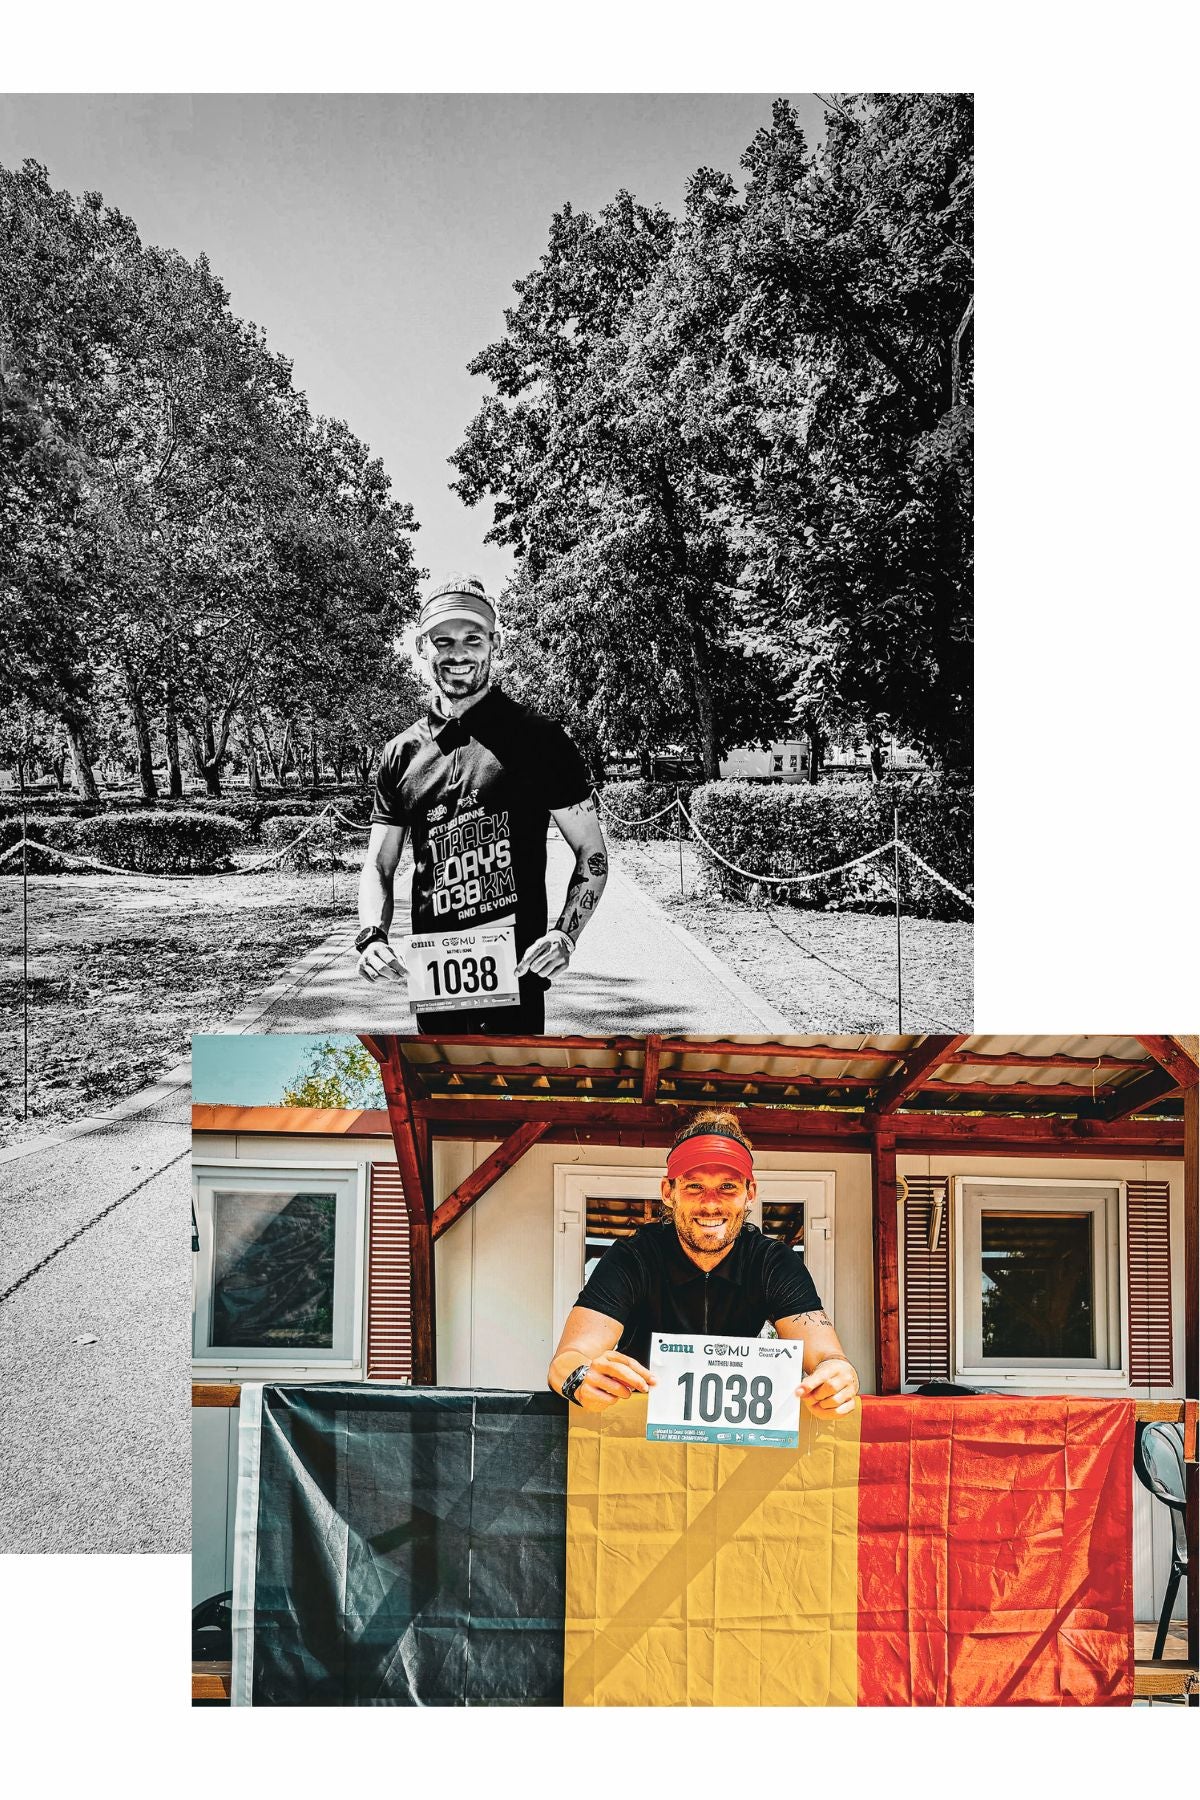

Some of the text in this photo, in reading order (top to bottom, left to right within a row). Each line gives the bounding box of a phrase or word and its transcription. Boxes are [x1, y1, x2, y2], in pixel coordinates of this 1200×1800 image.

[458, 806, 485, 824] BONNE
[458, 893, 518, 920] AND BEYOND
[411, 940, 435, 949] emu
[426, 956, 498, 996] 1038
[660, 1343, 694, 1354] emu
[678, 1372, 773, 1425] 1038
